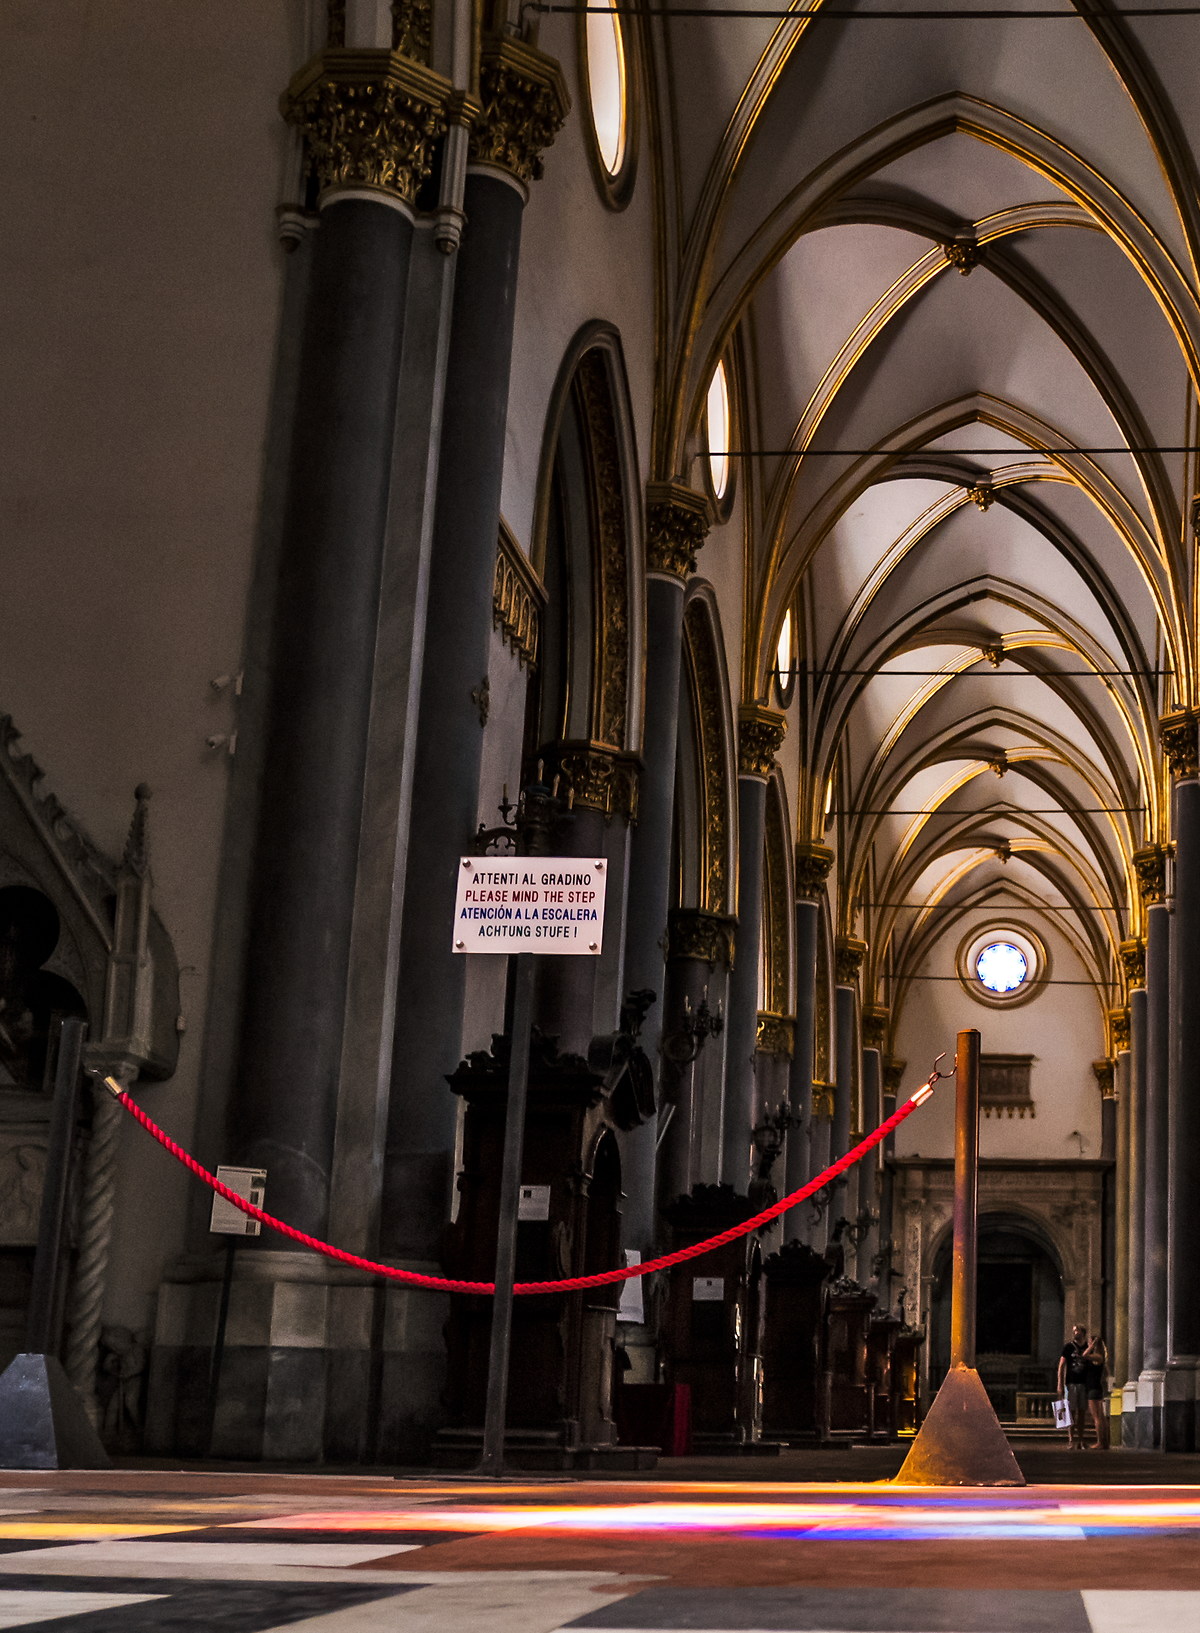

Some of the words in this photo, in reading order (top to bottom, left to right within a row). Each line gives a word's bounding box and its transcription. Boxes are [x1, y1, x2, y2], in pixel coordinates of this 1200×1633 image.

[472, 872, 518, 885] ATTENTI
[522, 873, 536, 885] AL
[541, 873, 591, 885] GRADINO
[465, 890, 508, 902] PLEASE
[512, 891, 539, 903] MIND
[543, 891, 563, 903] THE
[568, 891, 596, 903] STEP
[460, 904, 512, 920] ATENCIÓN
[514, 908, 522, 920] A
[525, 908, 539, 920] LA
[542, 908, 598, 921] ESCALERA
[478, 925, 531, 937] ACHTUNG
[535, 926, 570, 938] STUFE
[573, 926, 578, 938] !
